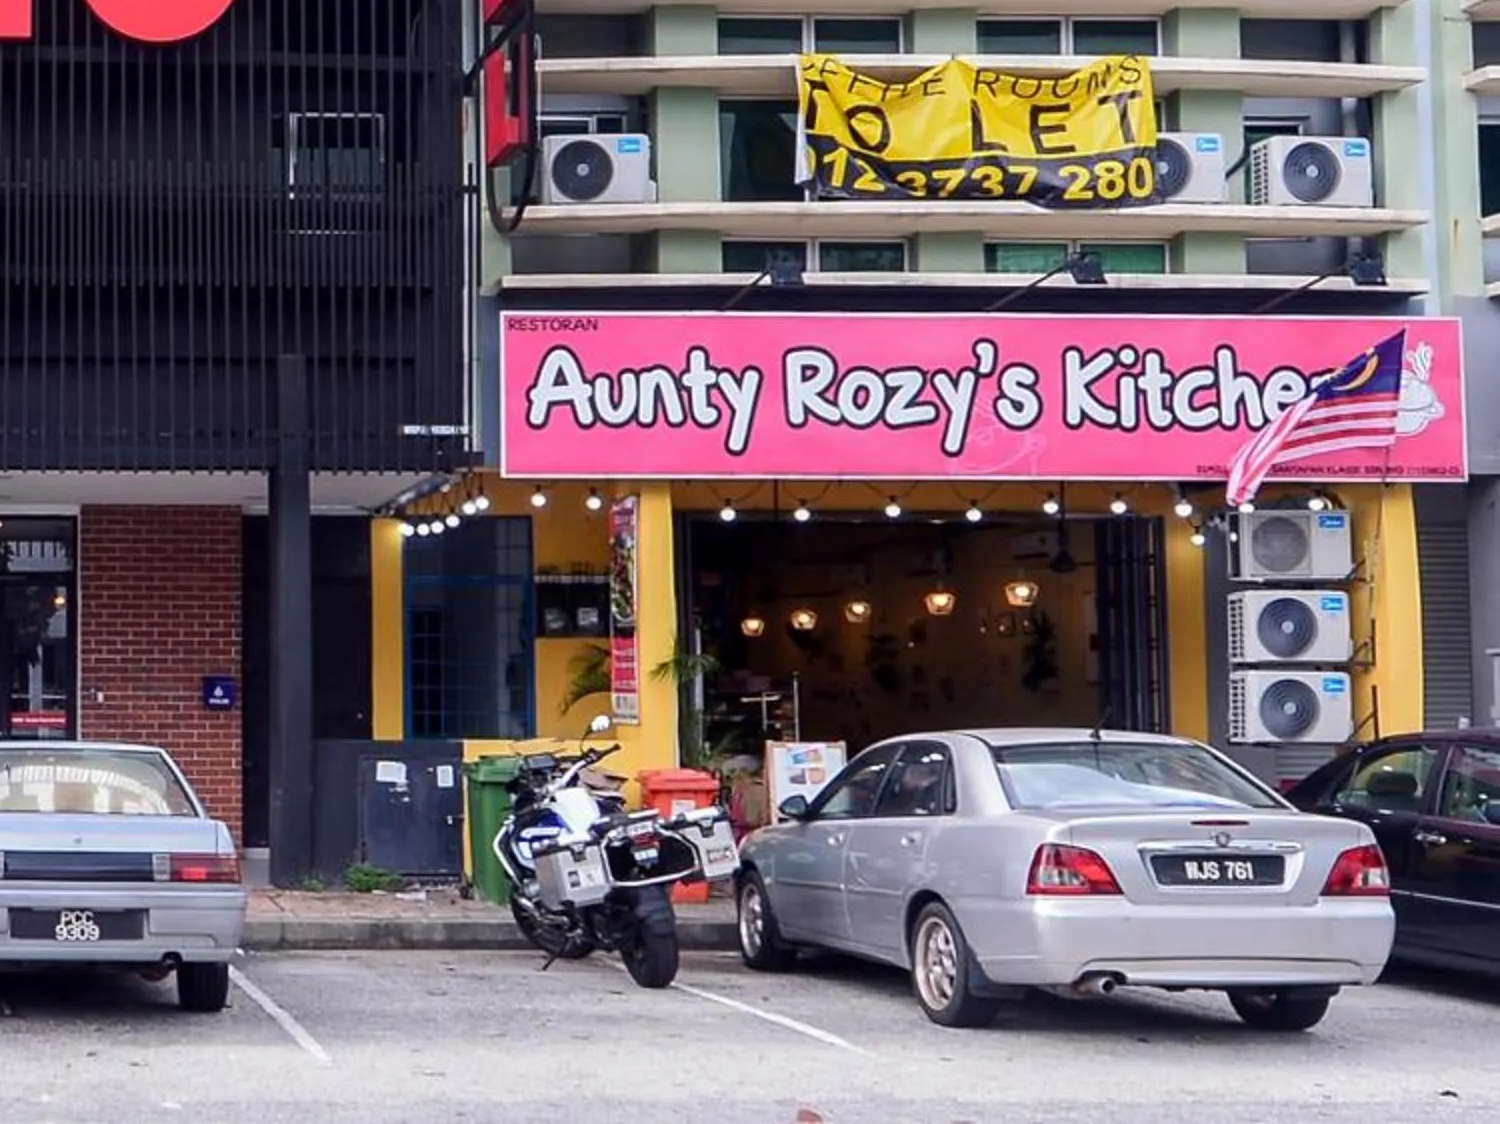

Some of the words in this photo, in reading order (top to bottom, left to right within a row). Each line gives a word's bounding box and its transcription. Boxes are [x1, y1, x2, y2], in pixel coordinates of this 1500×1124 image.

[803, 78, 891, 153] TO
[970, 90, 1145, 156] LET
[507, 317, 599, 332] RESTORAN
[526, 344, 762, 456] Aunty
[782, 337, 1043, 456] Rozy's
[1062, 343, 1334, 434] Kitche
[1224, 862, 1253, 880] 761
[60, 911, 94, 926] PCC
[55, 925, 100, 941] 9309
